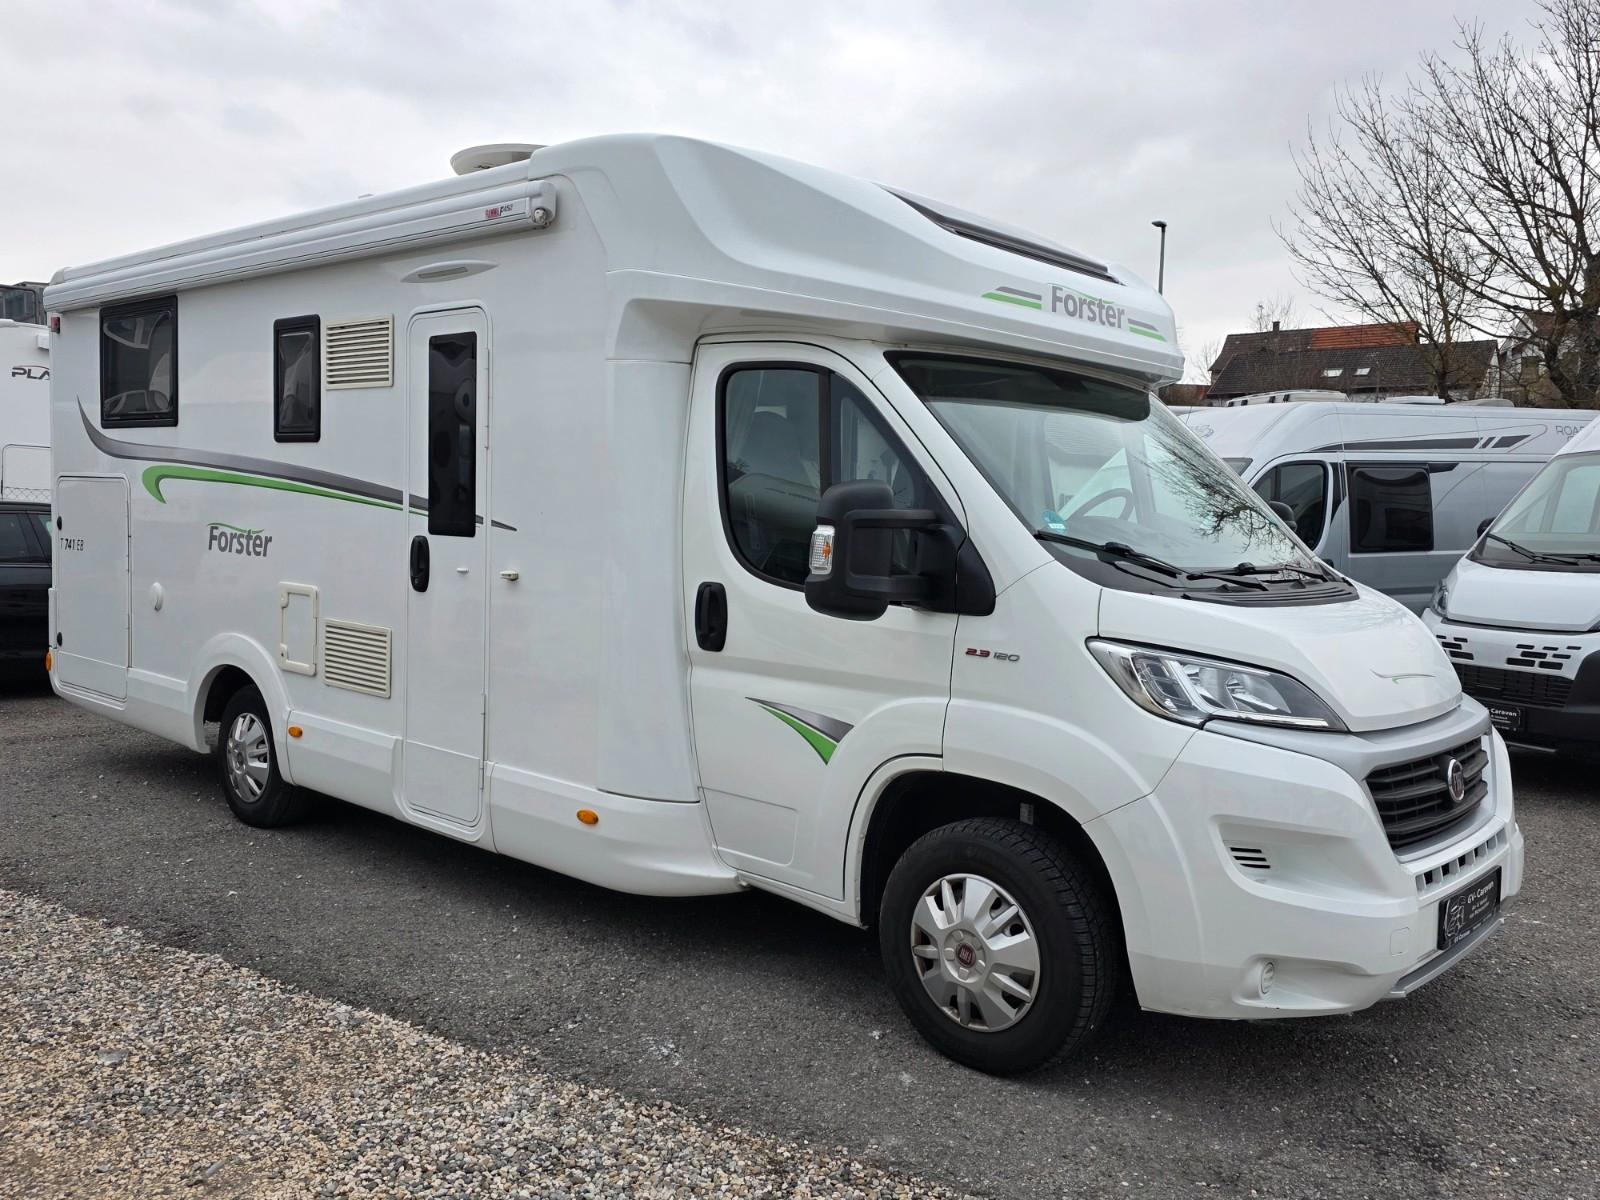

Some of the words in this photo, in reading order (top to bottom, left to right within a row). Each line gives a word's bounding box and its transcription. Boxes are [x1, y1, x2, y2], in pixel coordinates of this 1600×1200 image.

[1052, 285, 1126, 329] Forster
[1555, 425, 1585, 436] ROA
[65, 538, 76, 551] 741
[208, 525, 273, 557] Forster
